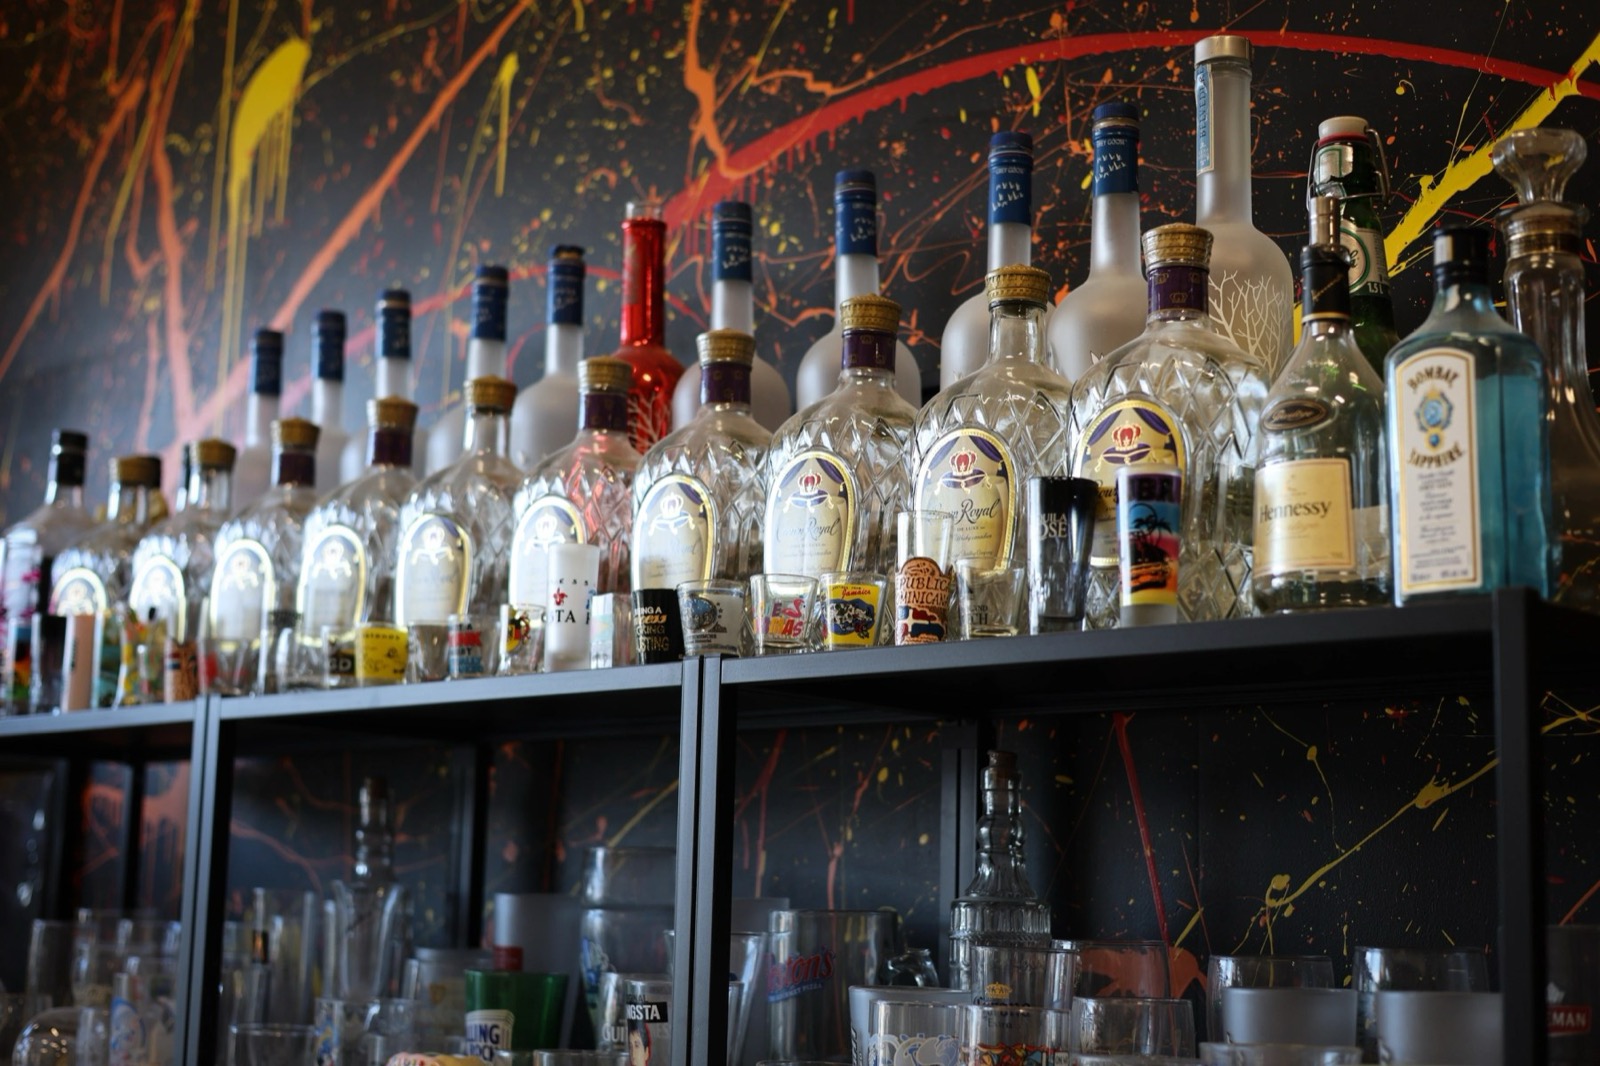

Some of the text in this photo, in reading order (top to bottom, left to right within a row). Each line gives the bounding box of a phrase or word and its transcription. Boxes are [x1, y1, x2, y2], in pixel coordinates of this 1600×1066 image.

[1367, 282, 1379, 293] 1.5
[1407, 366, 1459, 394] BOMBAY
[1407, 441, 1465, 469] SAPPHIRE
[955, 498, 1001, 524] Royal
[1259, 500, 1332, 524] Hennessy
[806, 516, 841, 542] Royal
[1039, 521, 1068, 541] OSE
[841, 587, 872, 600] Jamaica
[900, 576, 949, 593] PUBLIC
[654, 606, 663, 614] A
[626, 1003, 661, 1021] NGSTA
